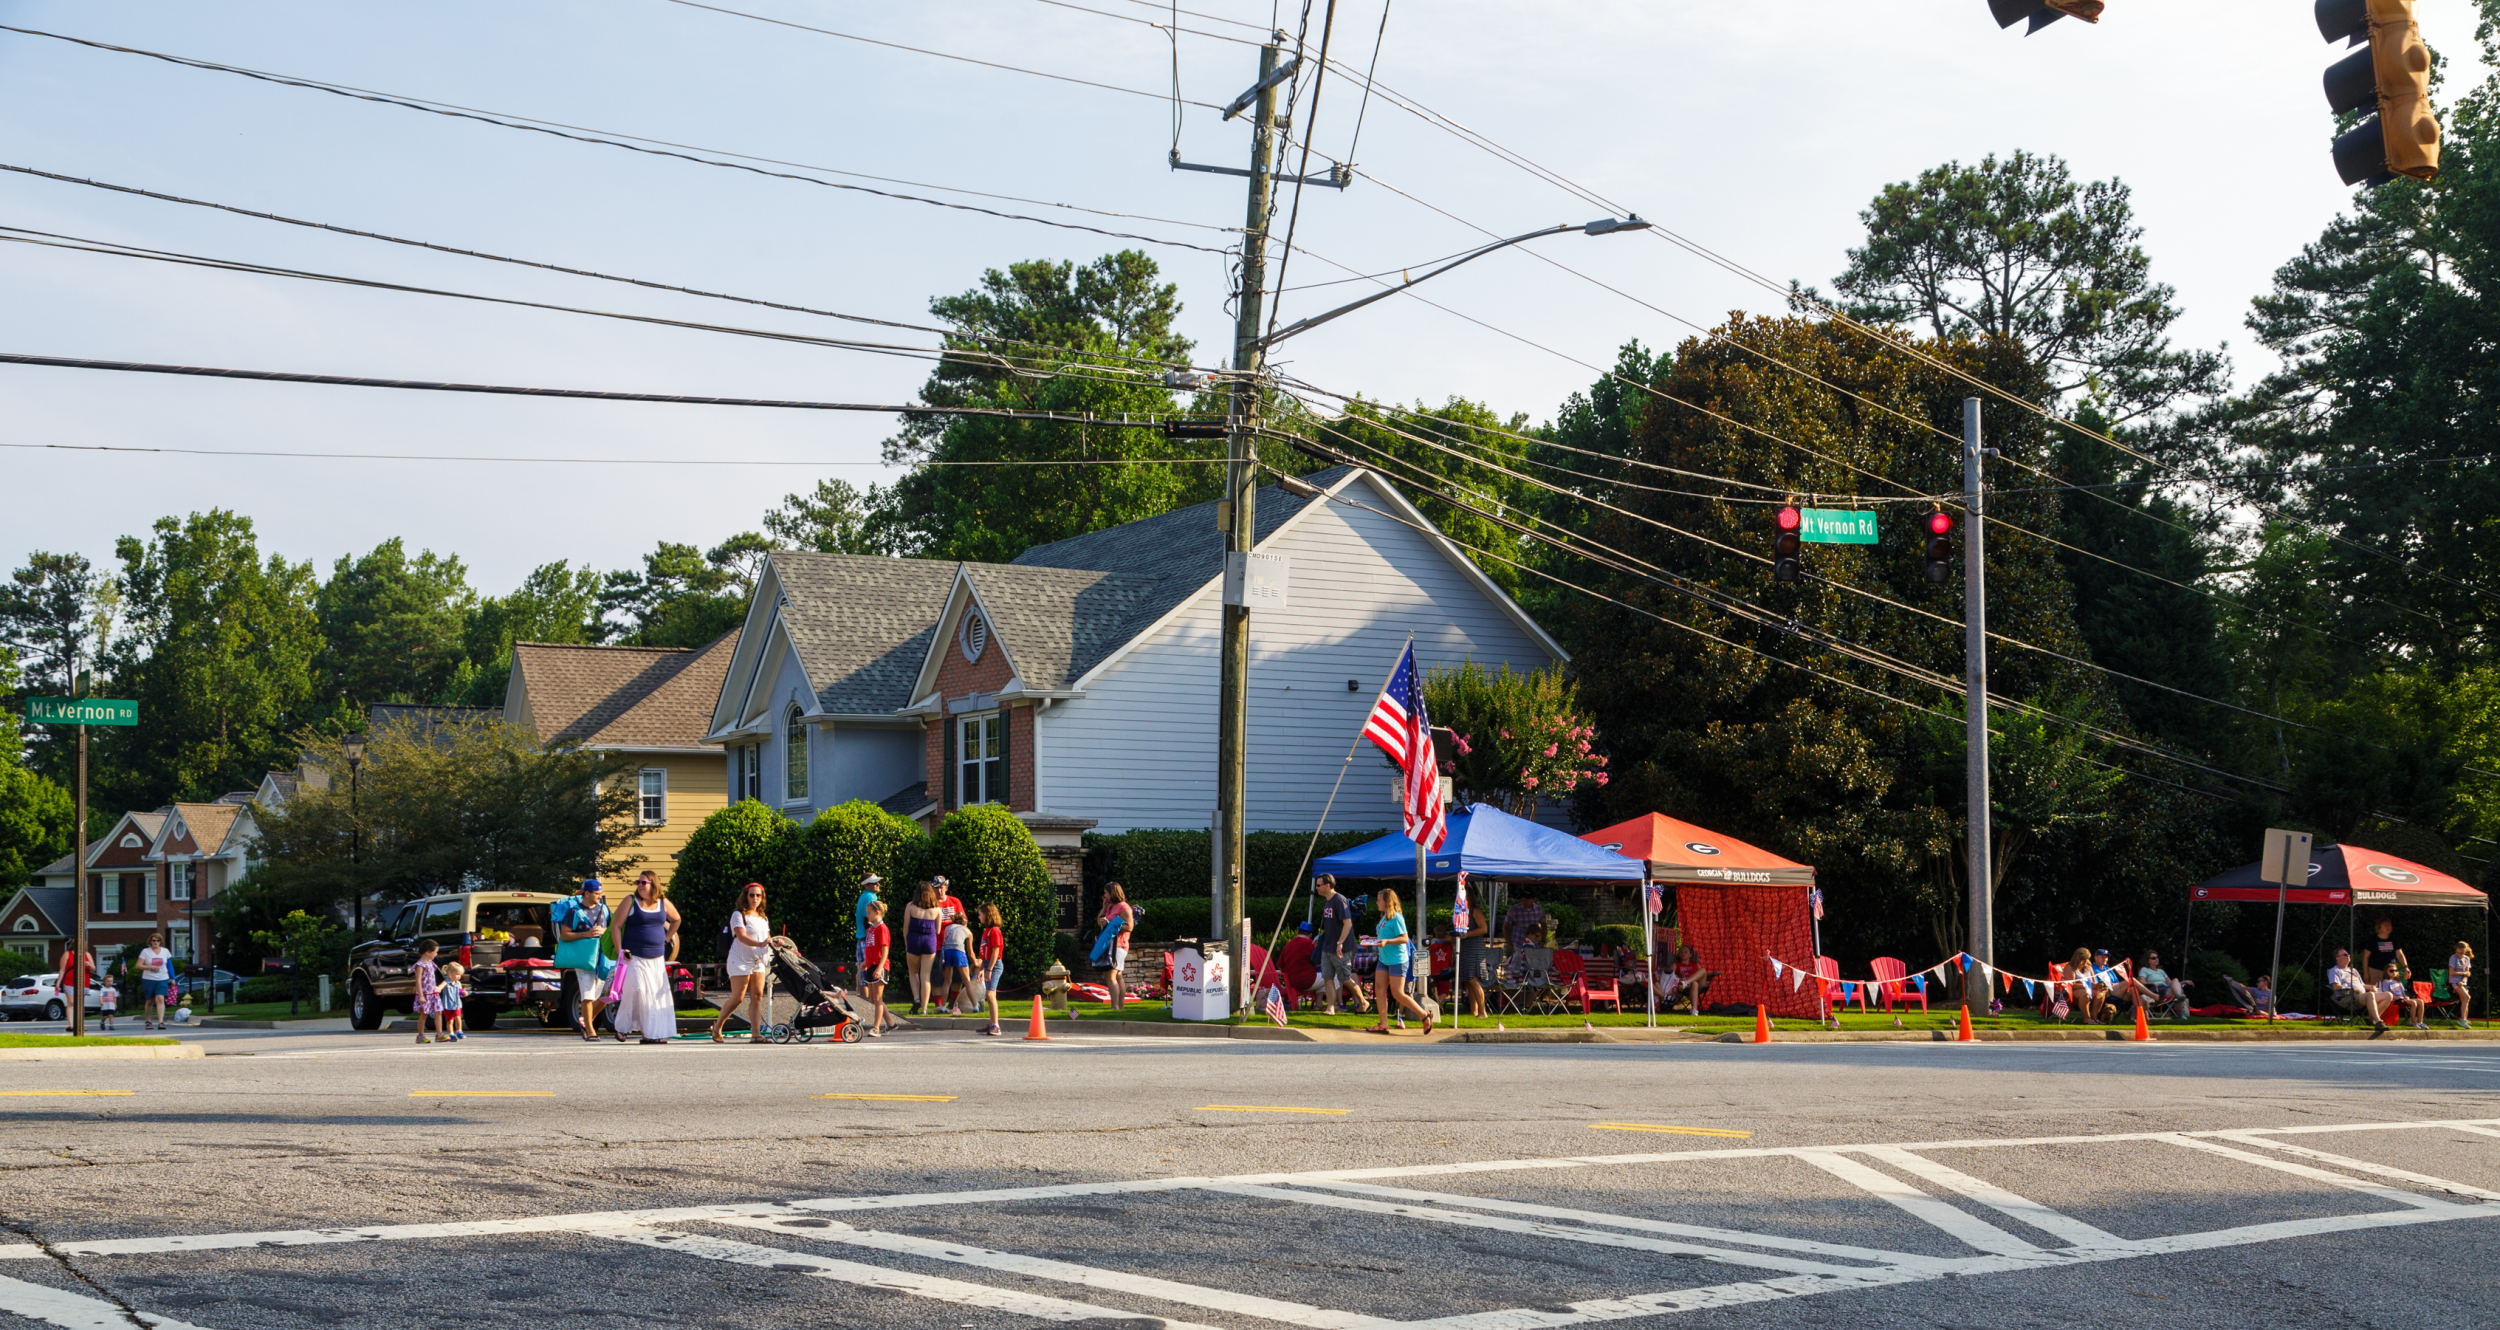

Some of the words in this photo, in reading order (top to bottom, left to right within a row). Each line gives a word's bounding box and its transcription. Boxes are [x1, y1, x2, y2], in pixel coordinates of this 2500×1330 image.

[1802, 517, 1814, 534] Mt
[1817, 517, 1856, 535] Vernon
[1859, 519, 1873, 535] Rd
[57, 703, 115, 720] Vernon
[120, 709, 132, 718] RD
[1697, 869, 1723, 877] GEORGIA
[1733, 871, 1771, 882] BULLDOGS
[2357, 891, 2397, 900] BULLDOGS
[1176, 985, 1202, 994] REPUBLIC
